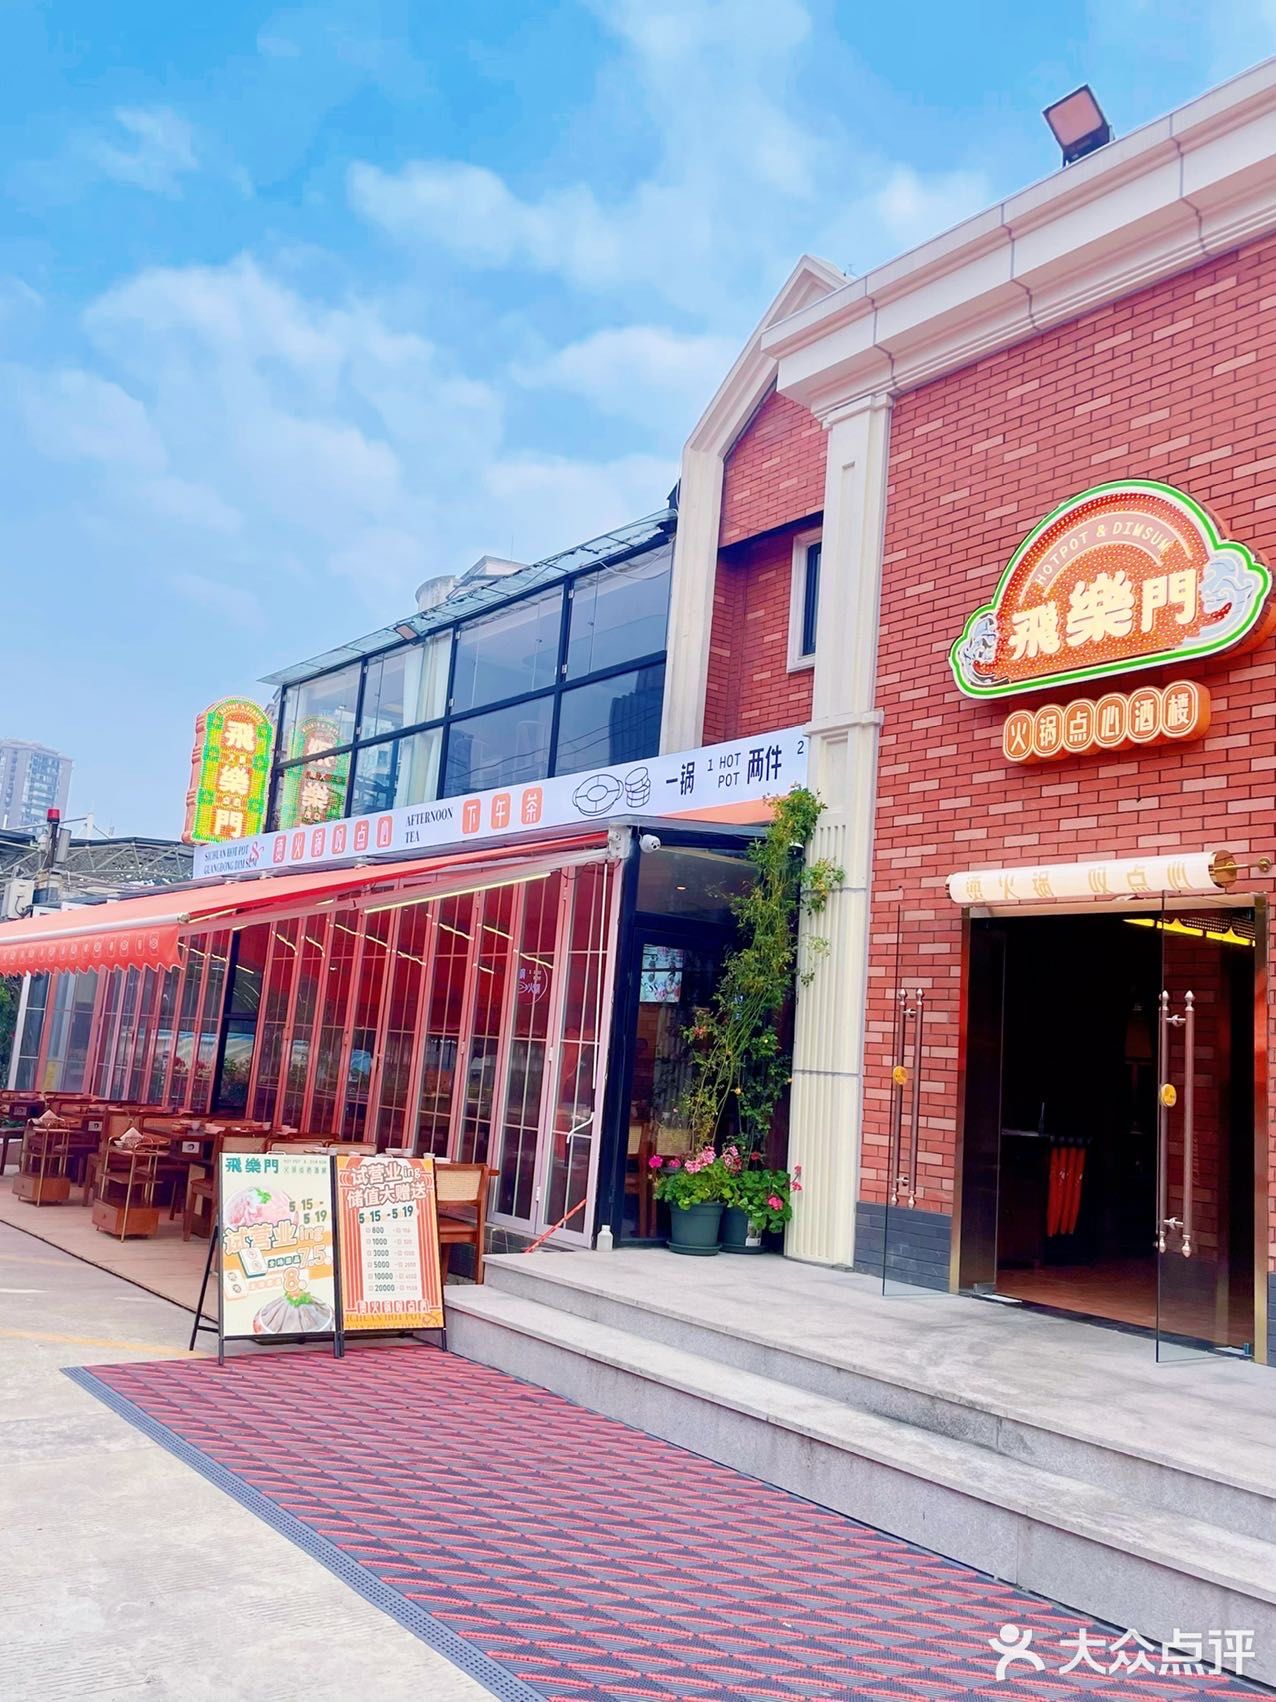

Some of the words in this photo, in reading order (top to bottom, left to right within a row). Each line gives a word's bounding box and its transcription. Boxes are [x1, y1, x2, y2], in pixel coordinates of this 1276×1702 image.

[1035, 532, 1089, 585] HOTPOT
[1096, 524, 1106, 537] &
[1112, 521, 1172, 553] DIMSUM
[1009, 569, 1198, 660] 飛樂門
[1010, 692, 1190, 753] 火锅点心酒楼
[796, 740, 805, 755] 2
[707, 759, 714, 772] 1
[719, 752, 742, 770] HOT
[747, 745, 782, 785] 两件
[665, 761, 696, 796] 一锅
[718, 772, 740, 789] POT
[405, 806, 453, 828] AFTERNOON
[466, 793, 539, 832] 下午茶
[405, 830, 420, 844] TEA
[225, 1156, 279, 1174] 飛樂門
[350, 1160, 404, 1186] 试营业
[403, 1165, 421, 1179] ing
[347, 1181, 427, 1209] 储值大赠送
[224, 1219, 297, 1255] 试营业
[299, 1224, 324, 1243] ing
[372, 1238, 388, 1246] 1000
[373, 1249, 389, 1257] 3000
[374, 1272, 393, 1280] 10000
[375, 1284, 395, 1292] 20000
